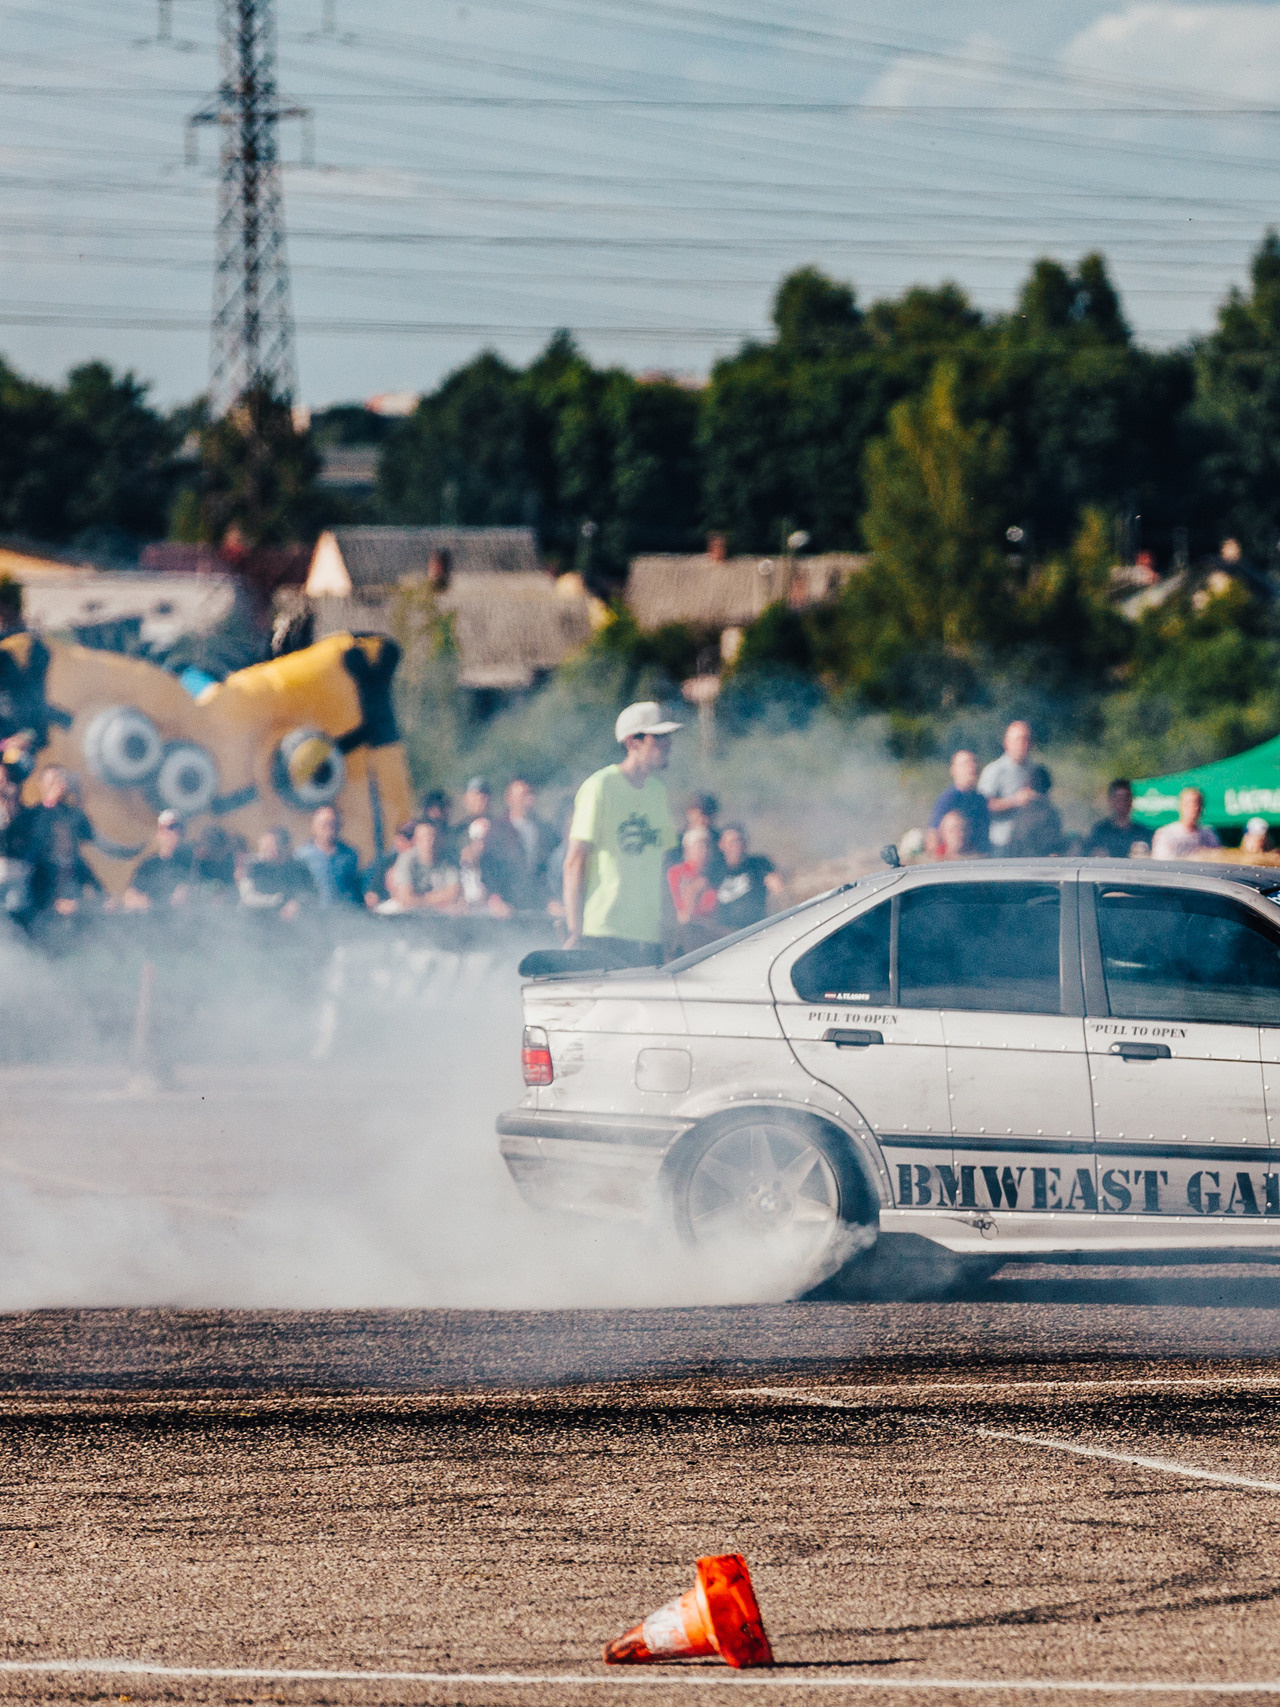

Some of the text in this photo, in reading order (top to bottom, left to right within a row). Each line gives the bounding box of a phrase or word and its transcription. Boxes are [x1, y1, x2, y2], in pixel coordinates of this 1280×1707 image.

[808, 1011, 899, 1025] PULL TO OPEN
[1094, 1024, 1188, 1038] PULL TO OPEN
[895, 1163, 1169, 1213] BMWEAST
